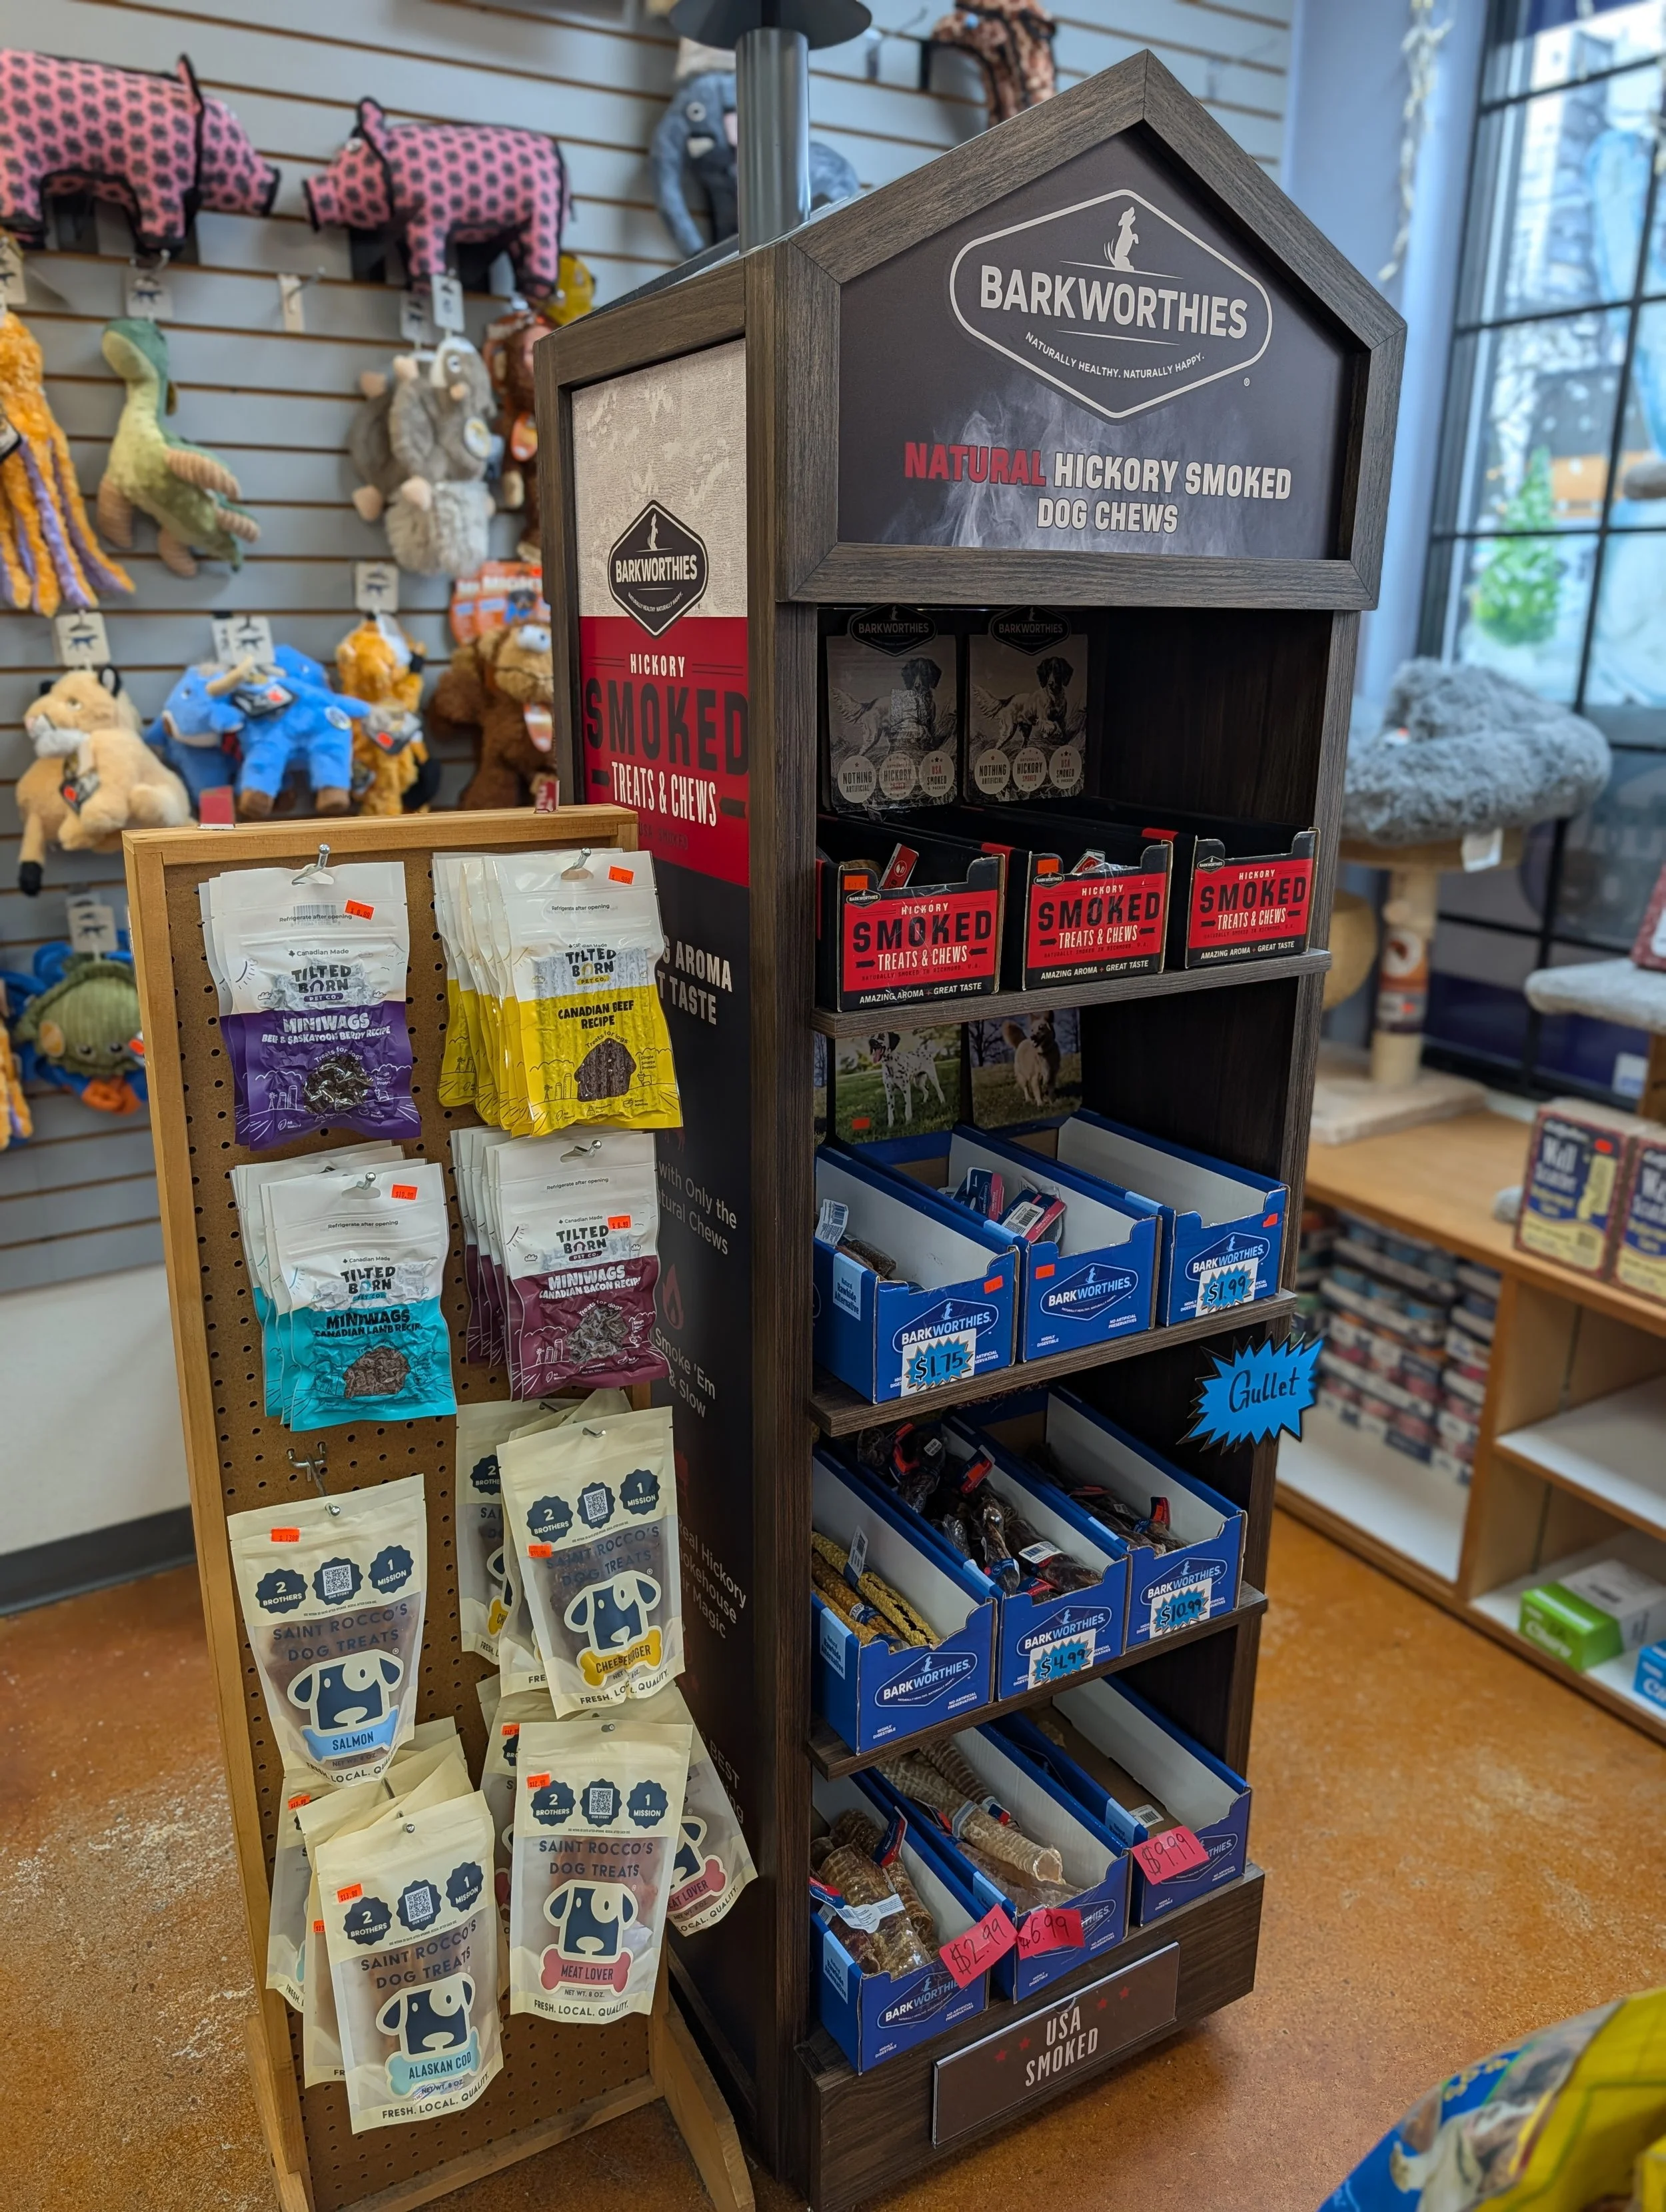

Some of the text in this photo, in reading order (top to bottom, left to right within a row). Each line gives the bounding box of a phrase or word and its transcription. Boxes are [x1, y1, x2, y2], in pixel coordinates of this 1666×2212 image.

[980, 265, 1248, 339] BARKWORTHIES
[1026, 331, 1205, 378] NATURALLY HEALTHY. NATURALLY HAPPY.
[904, 442, 1291, 500] NATURAL HICKORY SMOKED
[1037, 498, 1179, 533] DOG CHEWS
[616, 554, 697, 583] BARKWORTHIES
[630, 653, 685, 678] HICKORY
[586, 677, 749, 776] SMOKED
[842, 772, 872, 784] NOTHING
[931, 766, 942, 775] USA
[979, 764, 1007, 777] NOTHING
[611, 760, 718, 828] TREATS & CHEWS
[1200, 876, 1306, 913] SMOKED
[901, 902, 949, 915] HICKORY
[1038, 891, 1161, 931] SMOKED
[853, 910, 992, 953] SMOKED
[565, 947, 616, 965] TILTED
[675, 941, 733, 993] AROMA
[878, 945, 968, 971] TREATS & CHEWS
[291, 964, 351, 983] TILTED
[572, 960, 614, 977] BARN
[1041, 960, 1149, 980] AMAZING AROMA GREAT TASTE
[299, 979, 349, 993] BARN
[859, 981, 982, 1004] AMAZING AROMA GREAT TASTE
[558, 999, 634, 1021] CANADIAN BEEF
[669, 976, 717, 1026] TASTE
[283, 1013, 369, 1034] MINIWAGS
[581, 1015, 614, 1029] RECIPE
[314, 1048, 335, 1063] Treats
[349, 1049, 363, 1062] dogs
[658, 1159, 738, 1230] with Only the
[556, 1225, 609, 1241] TILTED
[548, 1265, 625, 1291] MINIWAGS
[1208, 1275, 1246, 1304] $1.99
[835, 1291, 859, 1315] Alternative
[838, 1282, 856, 1303] Rawhide
[326, 1309, 411, 1328] MINIWAGS
[579, 1303, 596, 1317] Treats
[608, 1302, 622, 1311] dogs
[1117, 1314, 1136, 1323] ARTIFICIAL
[1108, 1318, 1137, 1329] PRESERVATIVES
[1037, 1338, 1059, 1347] DIGESTIBLE
[655, 1327, 716, 1400] Smoke 'Em
[915, 1351, 963, 1381] $1.75
[669, 1369, 706, 1418] & Slow
[1229, 1367, 1300, 1412] Gullet
[627, 1494, 656, 1506] MISSION
[534, 1520, 569, 1534] BROTHERS
[544, 1508, 554, 1522] 2
[546, 1547, 591, 1569] SAINT
[597, 1525, 660, 1557] ROCCO'S
[562, 1550, 652, 1587] DOG TREATS
[678, 1516, 746, 1609] Real Hickory
[377, 1570, 407, 1586] MISSION
[263, 1593, 302, 1606] BROTHERS
[1160, 1598, 1202, 1625] $10.99
[273, 1624, 324, 1640] SAINT
[331, 1603, 408, 1632] ROCCO'S
[693, 1585, 726, 1639] Magic
[289, 1628, 399, 1661] DOG TREATS
[596, 1644, 652, 1674] CHEESEBURGER
[1040, 1648, 1085, 1678] $4.99
[956, 1692, 976, 1703] ARTIFICIAL
[333, 1730, 375, 1751] SALMON
[872, 1726, 896, 1740] DIGESTIBLE
[876, 1724, 892, 1733] HIGHLY
[710, 1740, 740, 1789] BEST
[549, 1794, 558, 1805] 2
[645, 1794, 650, 1805] 1
[538, 1840, 653, 1856] SAINT ROCCO'S
[1142, 1833, 1196, 1876] $9.99
[464, 1876, 469, 1888] 1
[550, 1862, 639, 1878] DOG TREATS
[455, 1886, 478, 1904] MISSION
[351, 1922, 388, 1937] BROTHERS
[1020, 1913, 1070, 1949] $6.99
[361, 1950, 409, 1971] SAINT
[416, 1920, 476, 1959] ROCCO'S
[950, 1917, 1006, 1975] $2.99
[376, 1946, 470, 1989] DOG TREATS
[561, 1963, 613, 1980] MEAT LOVER
[534, 1999, 629, 2017] FRESH. LOCAL. QUALITY.
[1046, 2006, 1081, 2046] USA
[409, 2051, 471, 2080] ALASKAN COD
[1025, 2027, 1098, 2087] SMOKED
[382, 2072, 489, 2119] FRESH. LOCAL. QUALITY.
